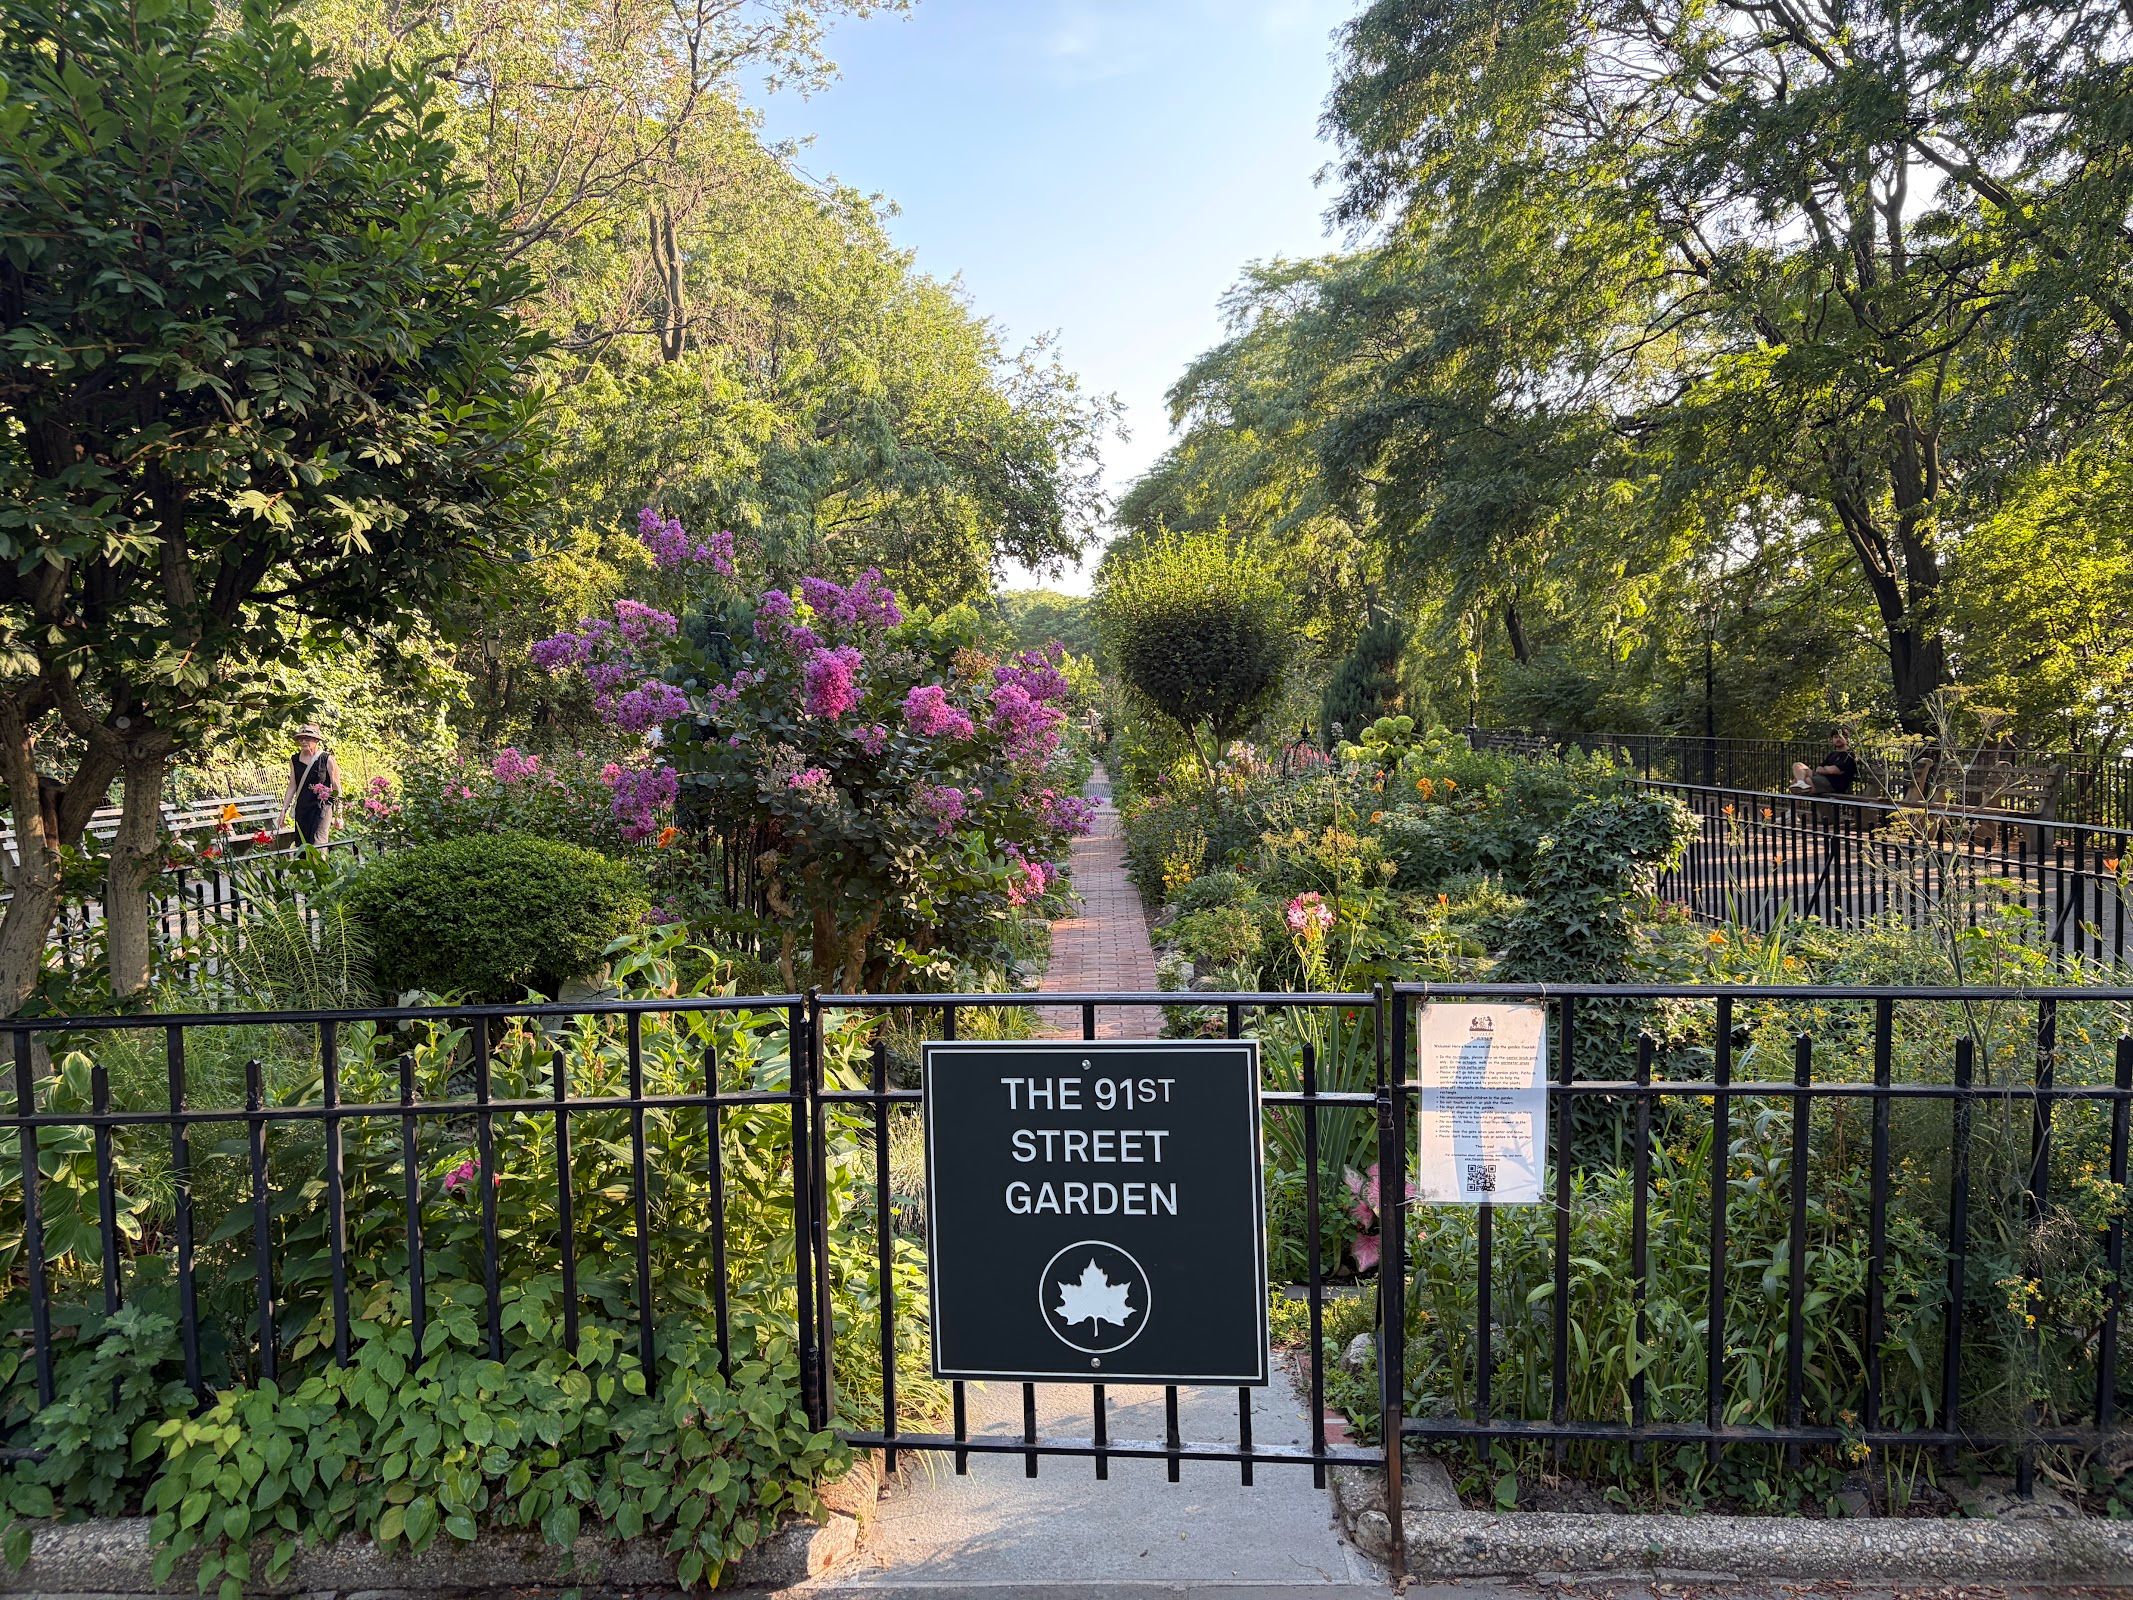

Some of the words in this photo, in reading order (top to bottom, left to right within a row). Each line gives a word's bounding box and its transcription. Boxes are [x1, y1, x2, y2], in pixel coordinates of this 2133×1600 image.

[1001, 1078, 1082, 1109] THE
[1095, 1078, 1175, 1110] 91ST
[1012, 1130, 1169, 1162] STREET
[1006, 1181, 1177, 1215] GARDEN
